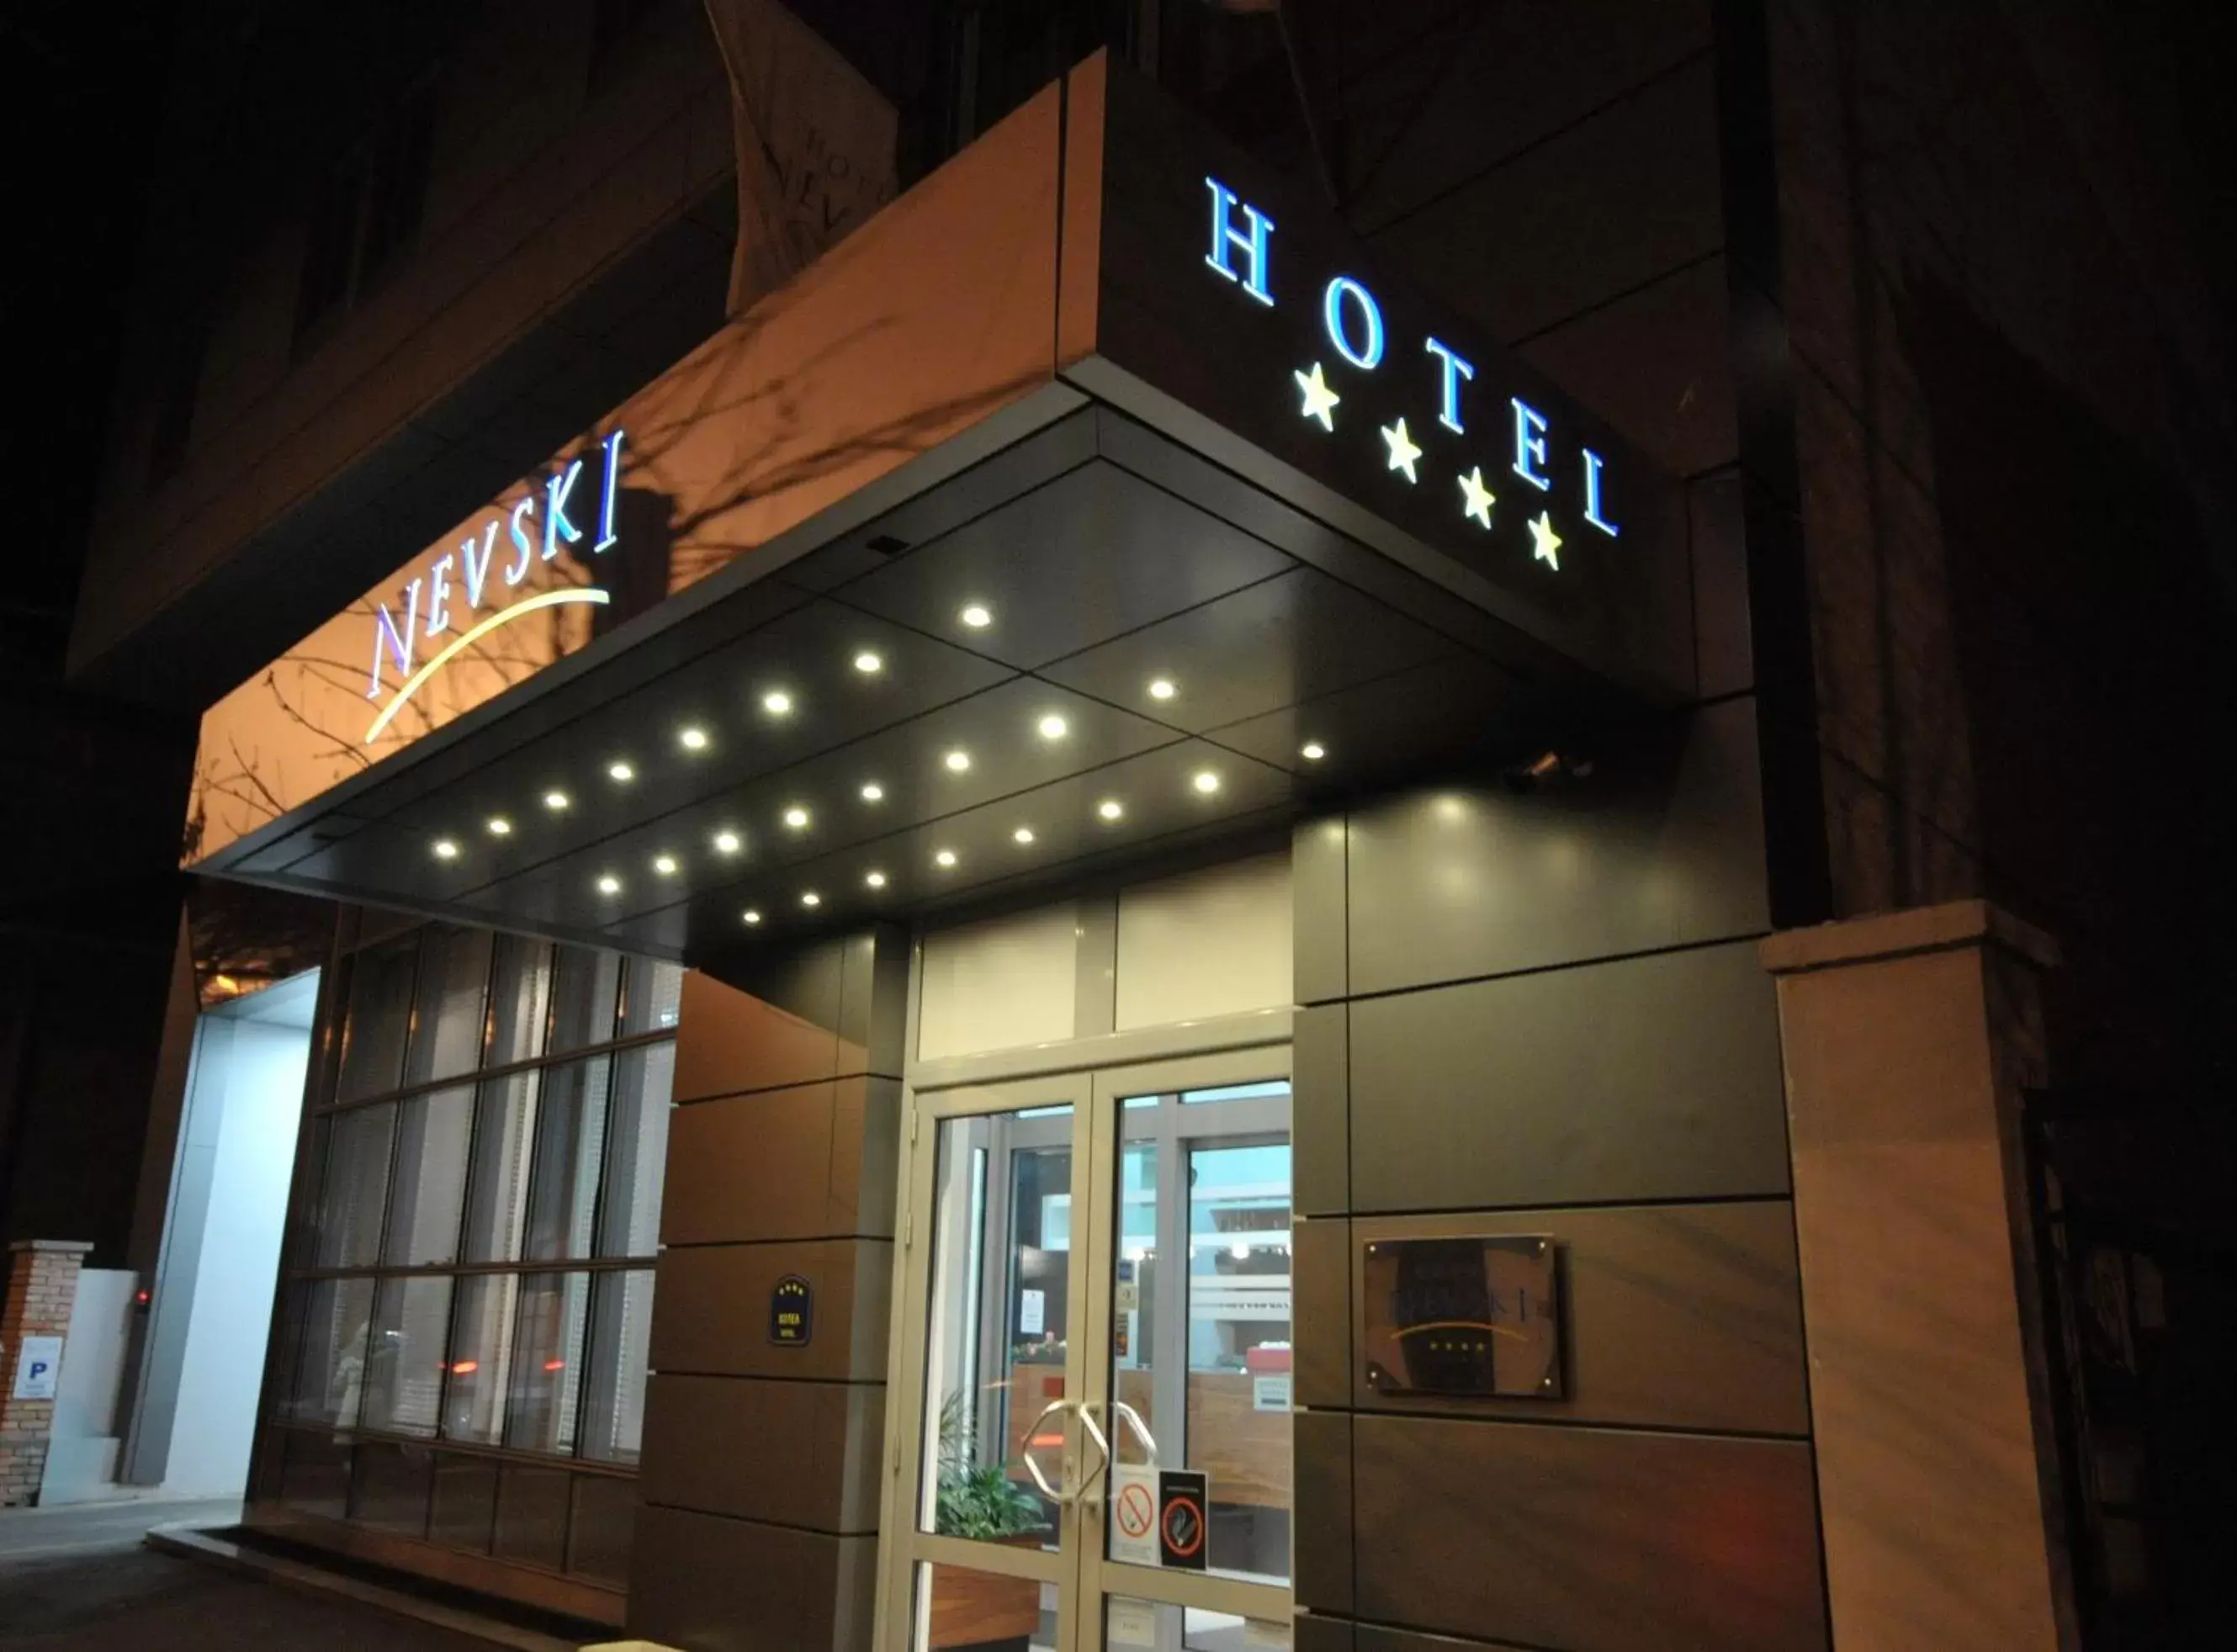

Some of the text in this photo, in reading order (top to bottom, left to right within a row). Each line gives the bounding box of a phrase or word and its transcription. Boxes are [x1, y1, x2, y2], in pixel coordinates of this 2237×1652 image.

[1205, 175, 1619, 538] HOTEL
[365, 429, 625, 700] NEVSKI
[29, 1362, 48, 1379] P
